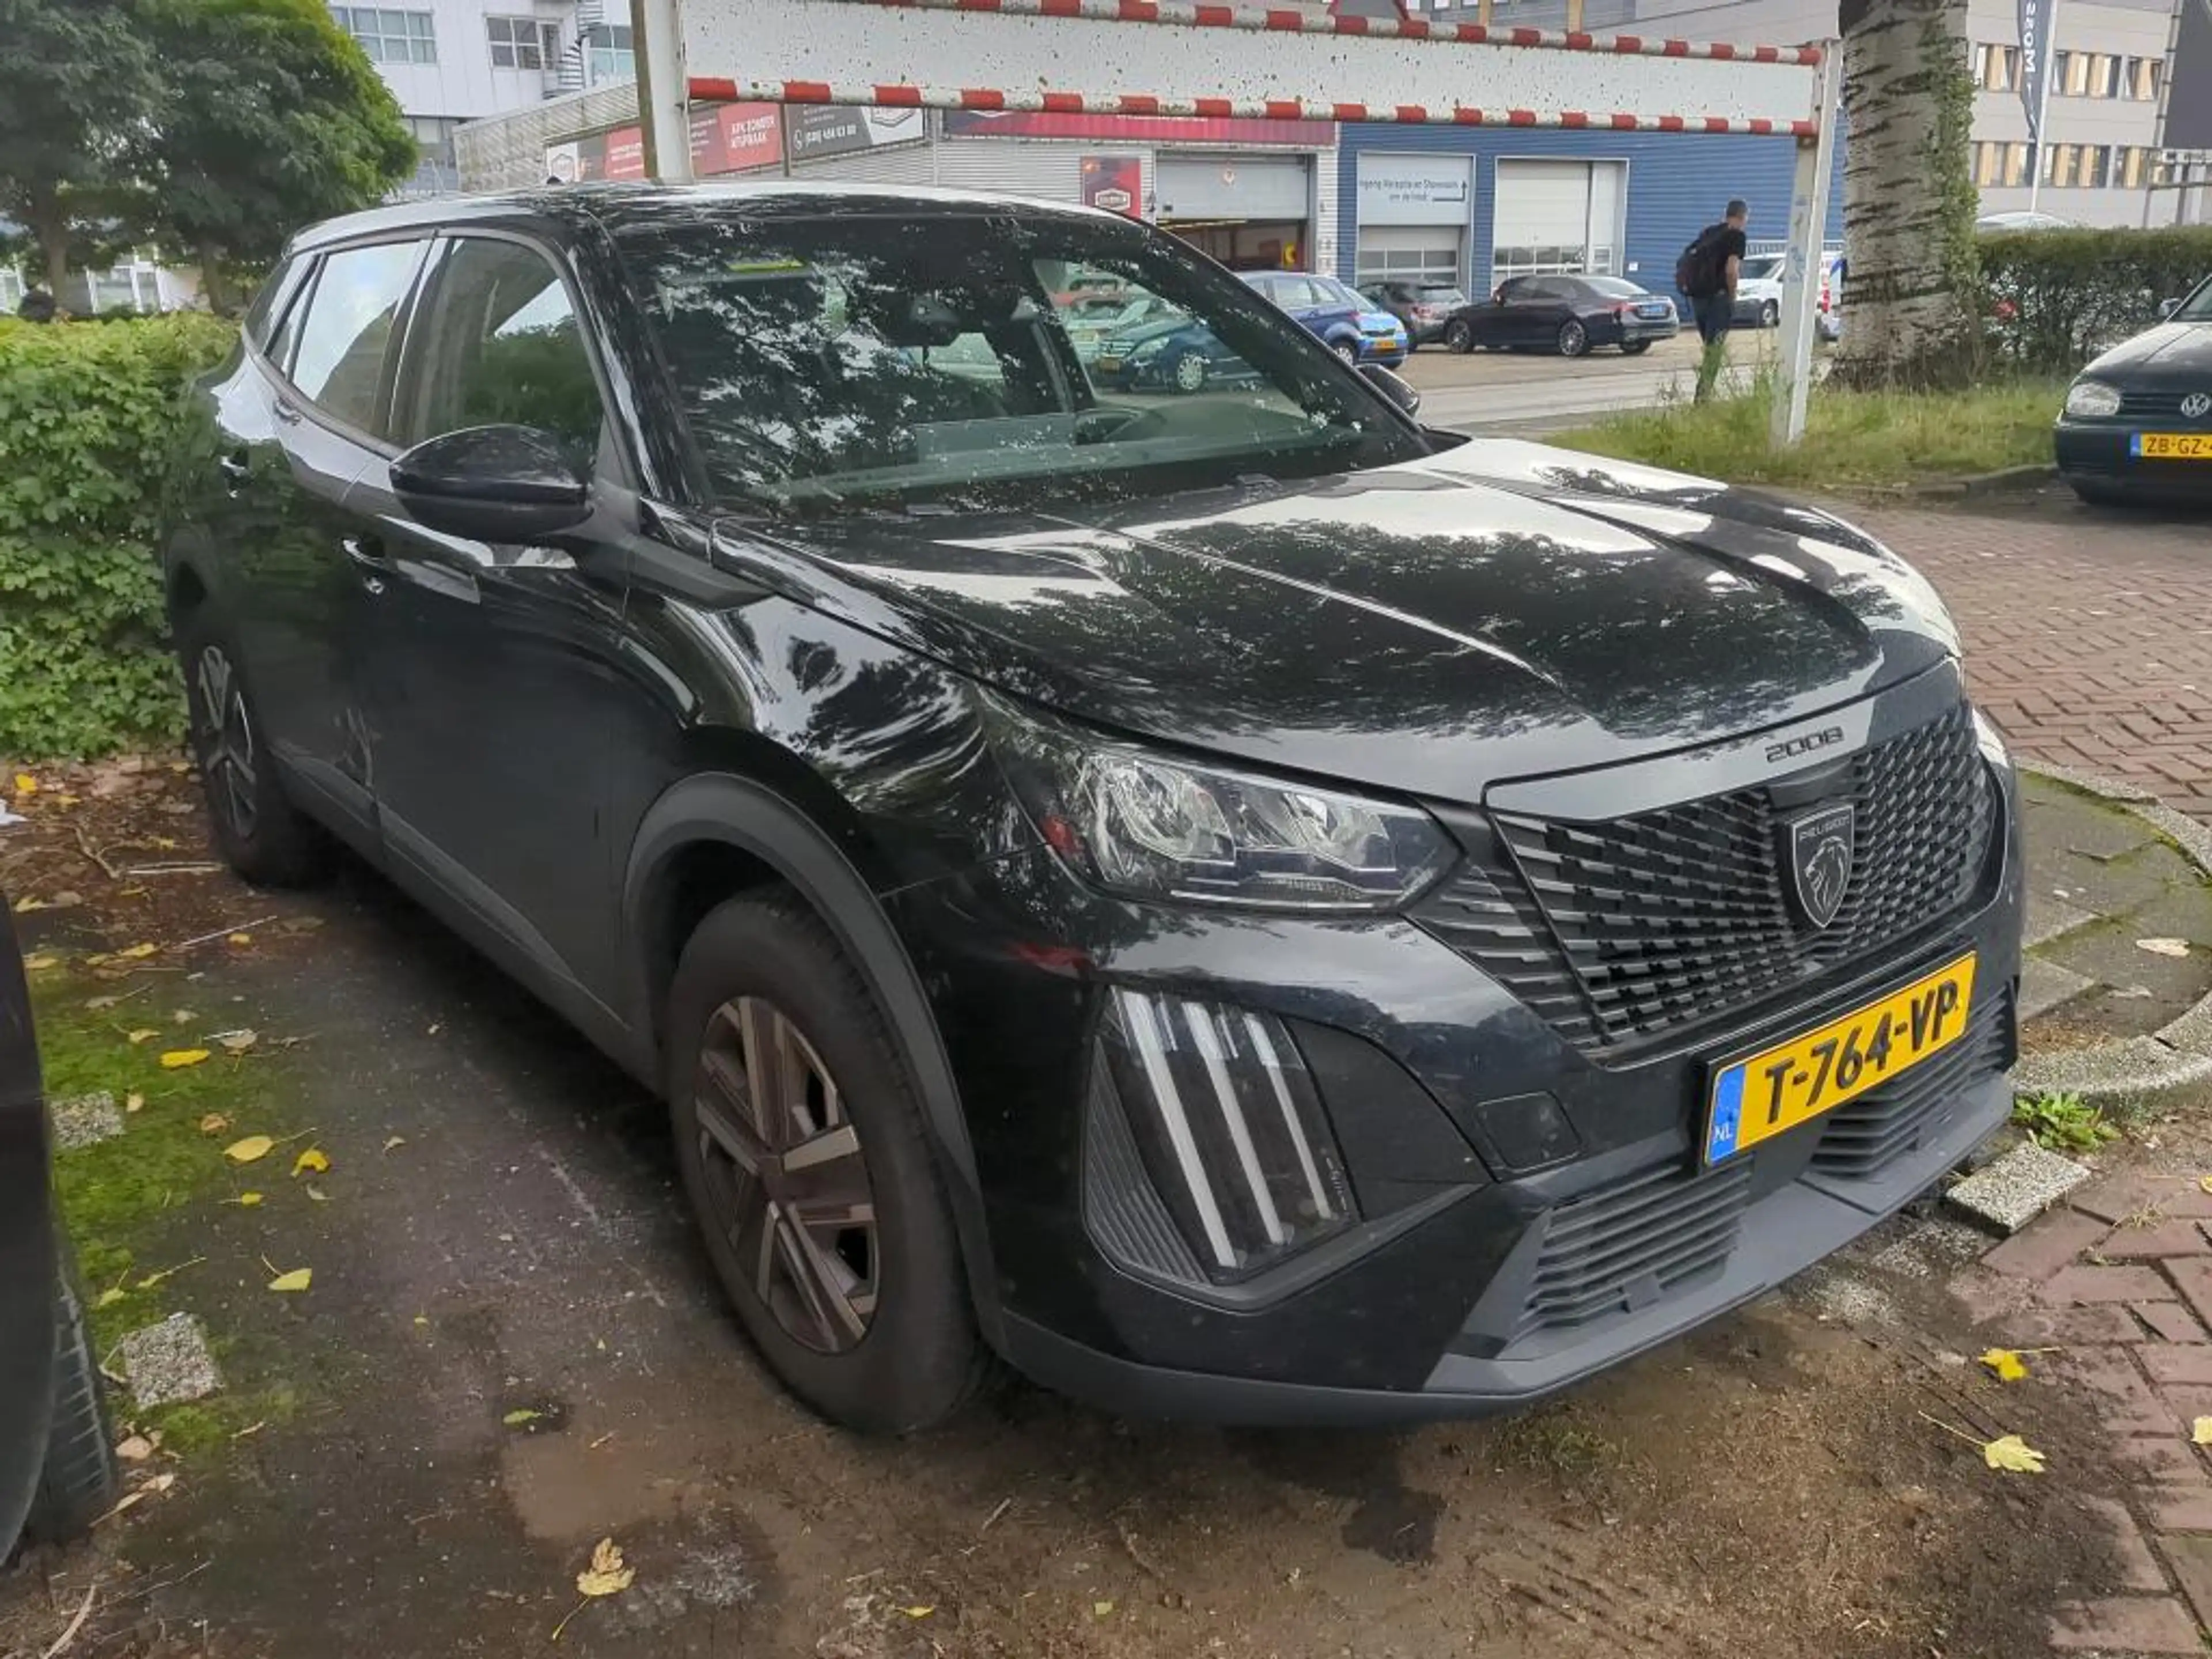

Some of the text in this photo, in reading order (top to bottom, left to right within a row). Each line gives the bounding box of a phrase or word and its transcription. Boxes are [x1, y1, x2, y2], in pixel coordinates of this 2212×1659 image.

[1764, 726, 1845, 763] 2008
[1764, 979, 1959, 1124] T-764-VP
[1714, 1121, 1733, 1141] NL
